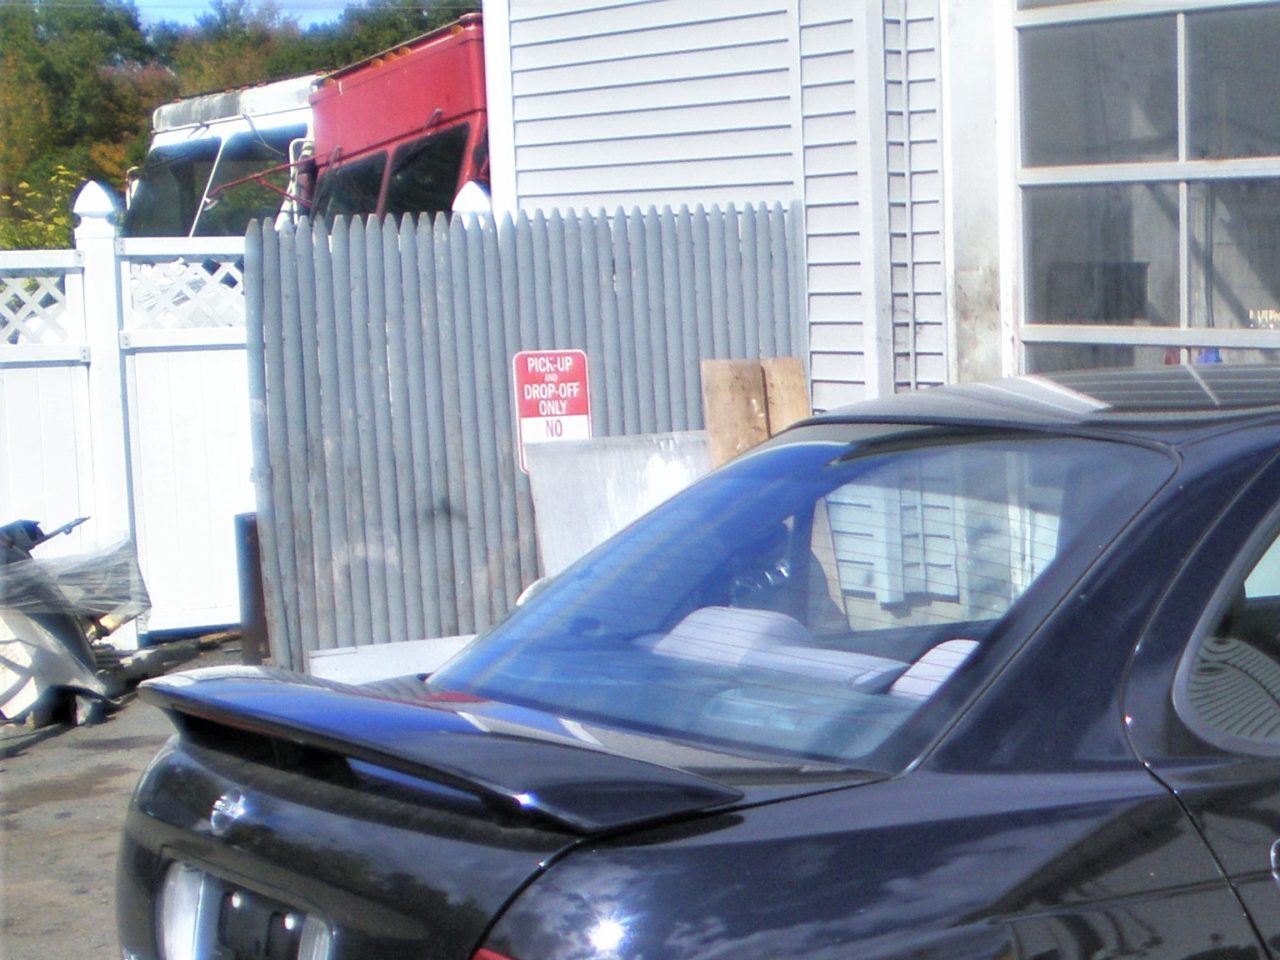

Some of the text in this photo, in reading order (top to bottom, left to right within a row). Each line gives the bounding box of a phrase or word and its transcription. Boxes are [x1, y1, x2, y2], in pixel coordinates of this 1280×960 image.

[527, 356, 574, 373] PICK-UP
[544, 373, 559, 382] AND
[523, 382, 580, 400] DROP-OFF
[538, 400, 568, 415] ONLY
[546, 419, 564, 437] NO
